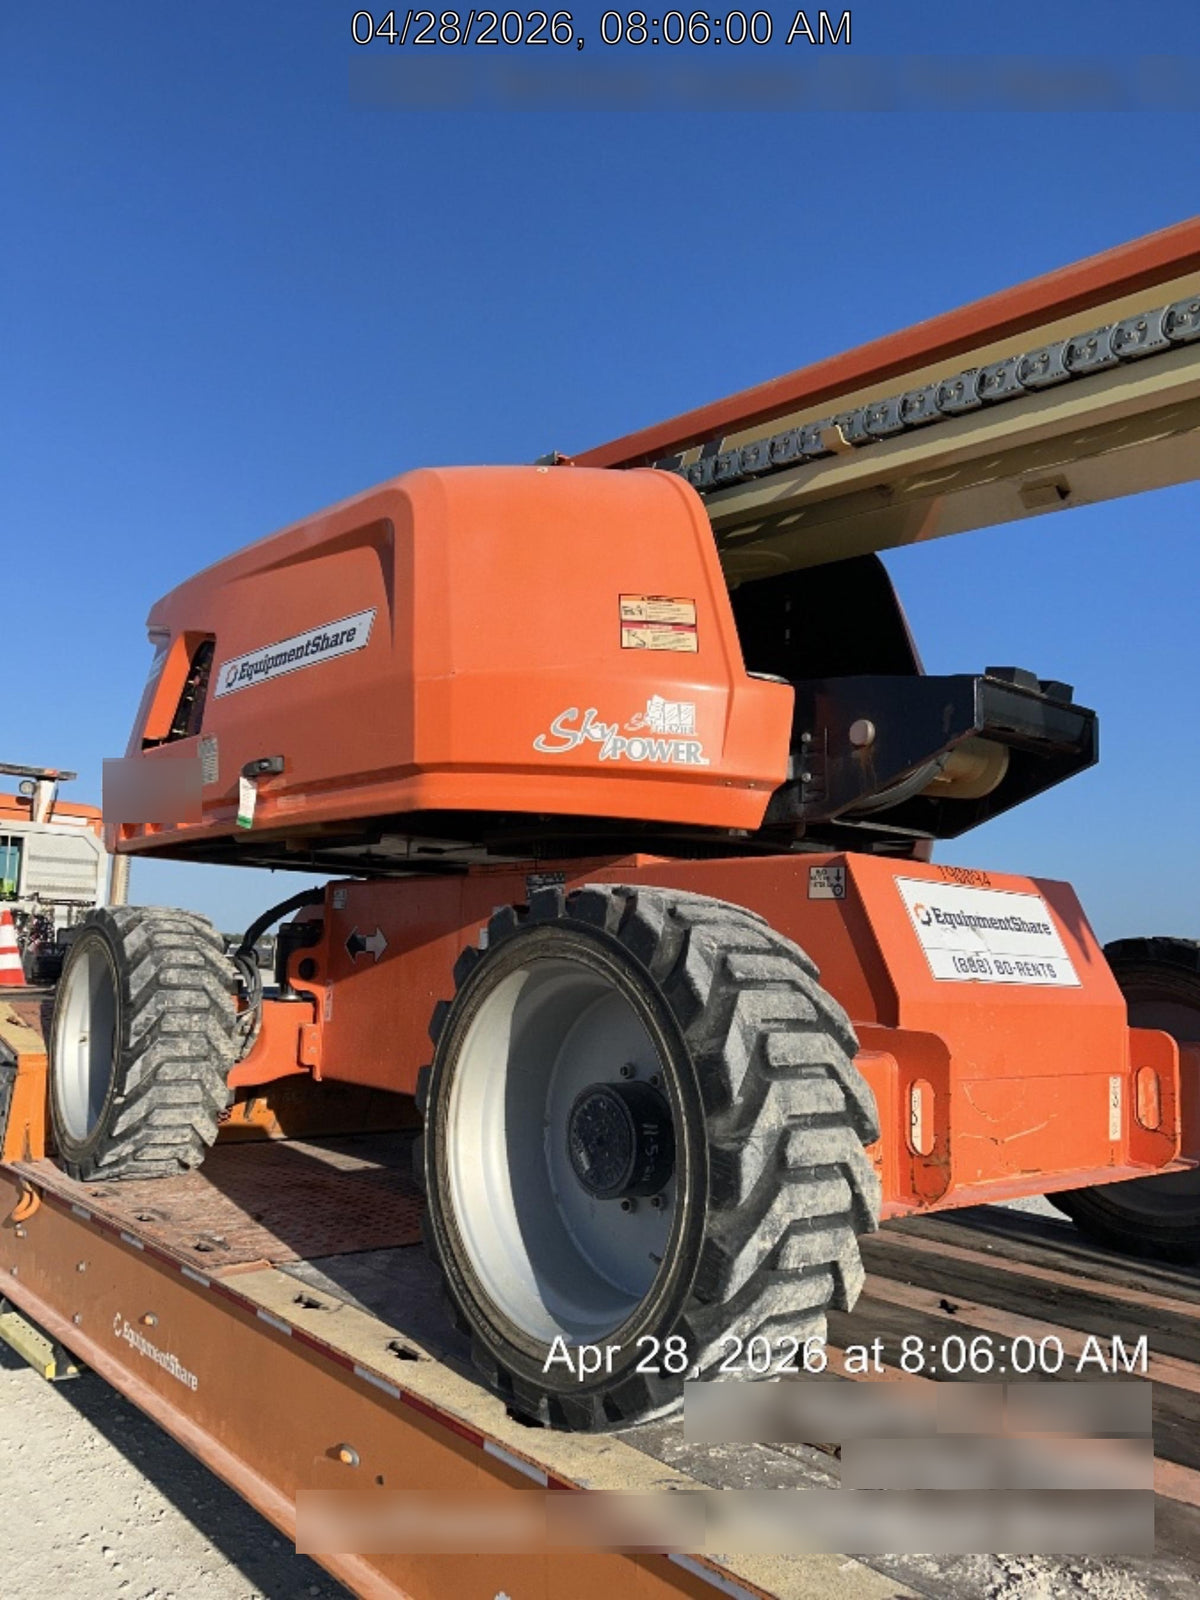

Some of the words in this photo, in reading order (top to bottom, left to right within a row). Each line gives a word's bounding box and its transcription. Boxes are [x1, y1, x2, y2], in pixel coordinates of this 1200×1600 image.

[237, 625, 358, 682] EquipmentShare
[533, 707, 620, 761] Sky
[611, 737, 707, 765] POWER
[933, 906, 1053, 936] EquipmentShare
[951, 955, 994, 976] (888)
[996, 958, 1058, 979] 80-RENTS
[121, 1320, 199, 1393] EquipmentShare
